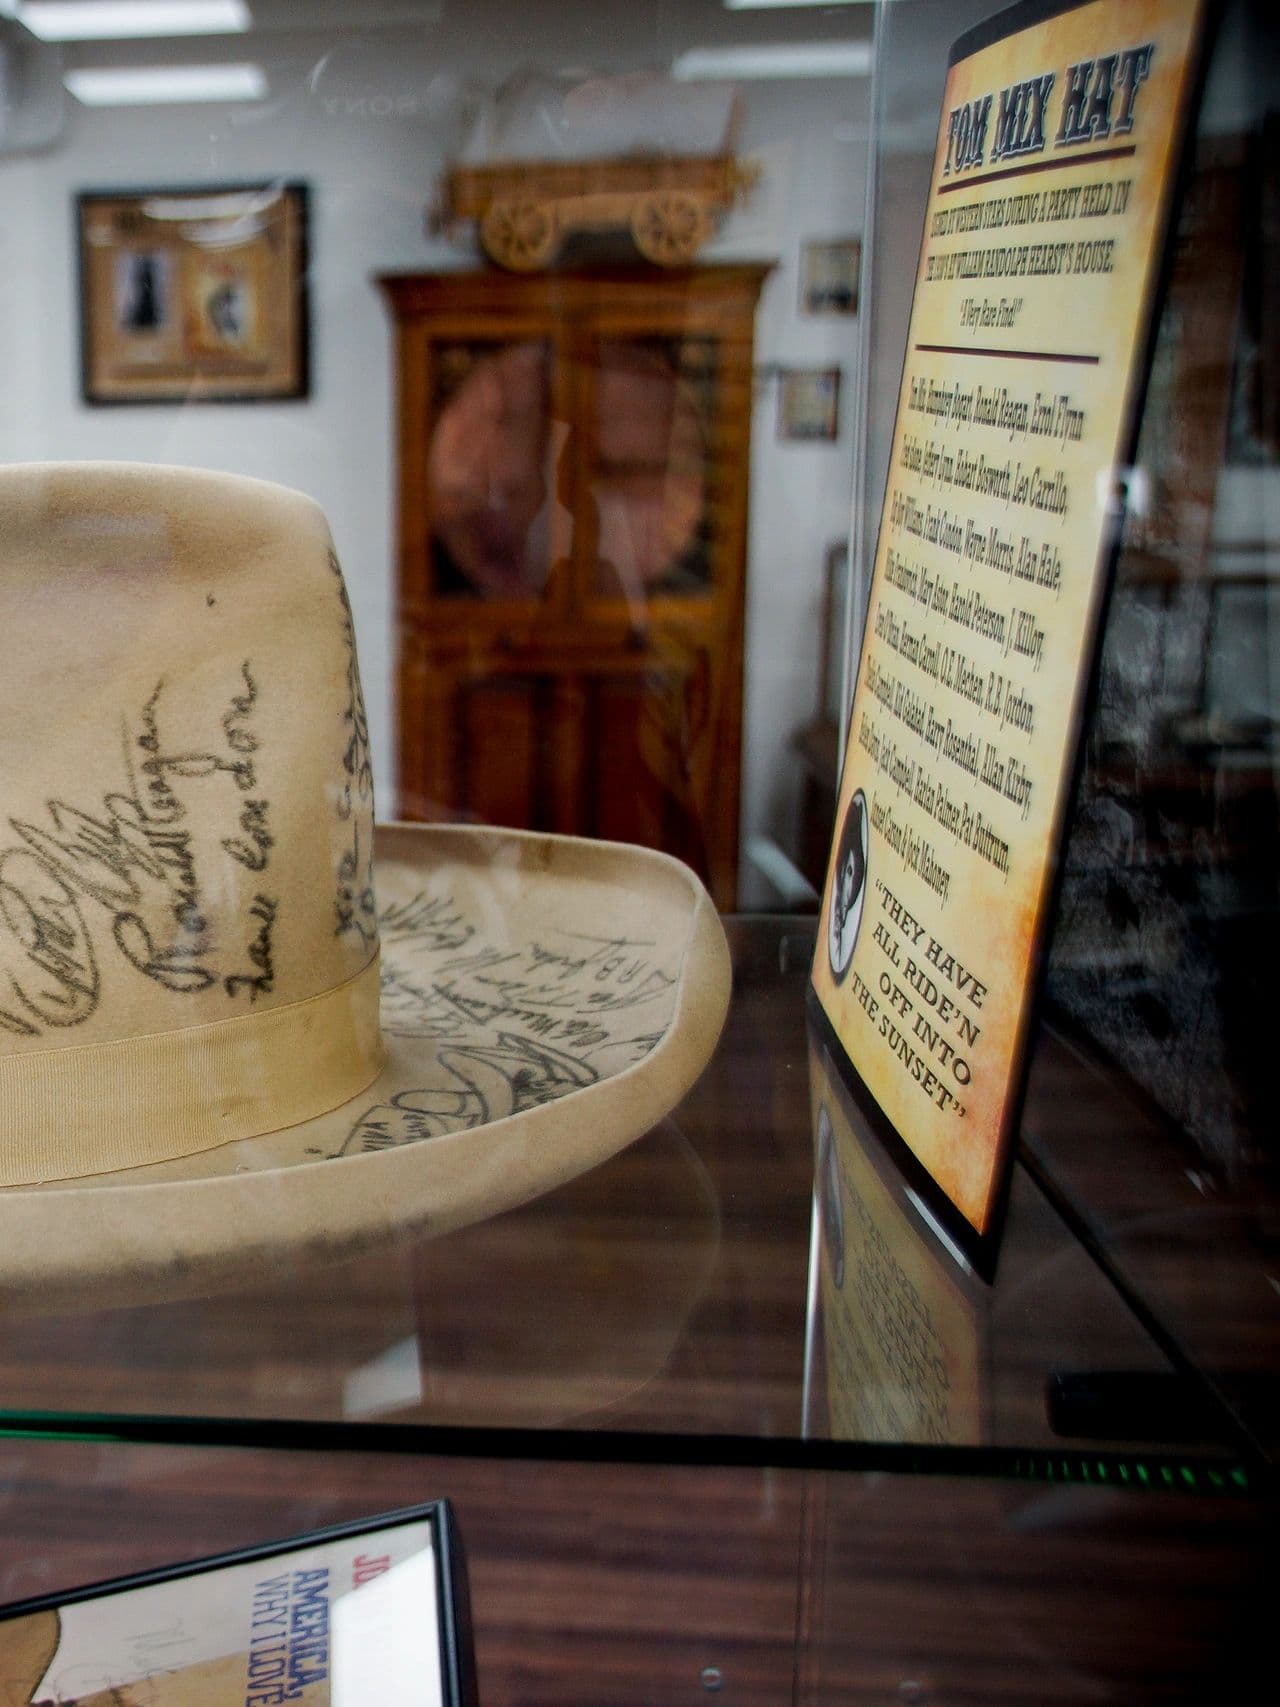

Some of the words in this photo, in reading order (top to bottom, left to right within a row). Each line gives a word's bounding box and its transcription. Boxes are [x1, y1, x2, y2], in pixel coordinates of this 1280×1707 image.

[943, 94, 992, 177] TOM
[990, 72, 1056, 163] MIX
[1054, 42, 1155, 148] HAT
[1005, 192, 1040, 227] DURING
[1046, 187, 1082, 222] PARTY
[1079, 182, 1113, 218] HELD
[1112, 180, 1132, 215] IN
[982, 246, 1029, 278] RANDOLPH
[1027, 242, 1074, 275] HEARST'S
[973, 385, 1002, 428] Ronald
[997, 388, 1029, 442] Reagan,
[1030, 392, 1058, 437] Errol
[1011, 462, 1029, 506] Leo
[1029, 466, 1067, 526] Carrillo,
[985, 526, 1014, 584] Morris,
[1014, 536, 1037, 583] Alan
[1036, 543, 1061, 602] Hale,
[980, 743, 1004, 793] Allan
[959, 802, 974, 846] Pat
[874, 877, 926, 947] "THEY
[924, 936, 988, 1010] HAVE
[871, 920, 901, 969] ALL
[902, 957, 980, 1049] RIDE'N
[851, 971, 880, 1023] THE
[878, 1015, 967, 1118] SUNSET"
[879, 971, 913, 1018] OFF
[912, 1014, 971, 1087] INTO
[252, 1572, 290, 1629] WHY
[250, 1631, 288, 1645] I
[287, 1567, 330, 1702] AMERICA,
